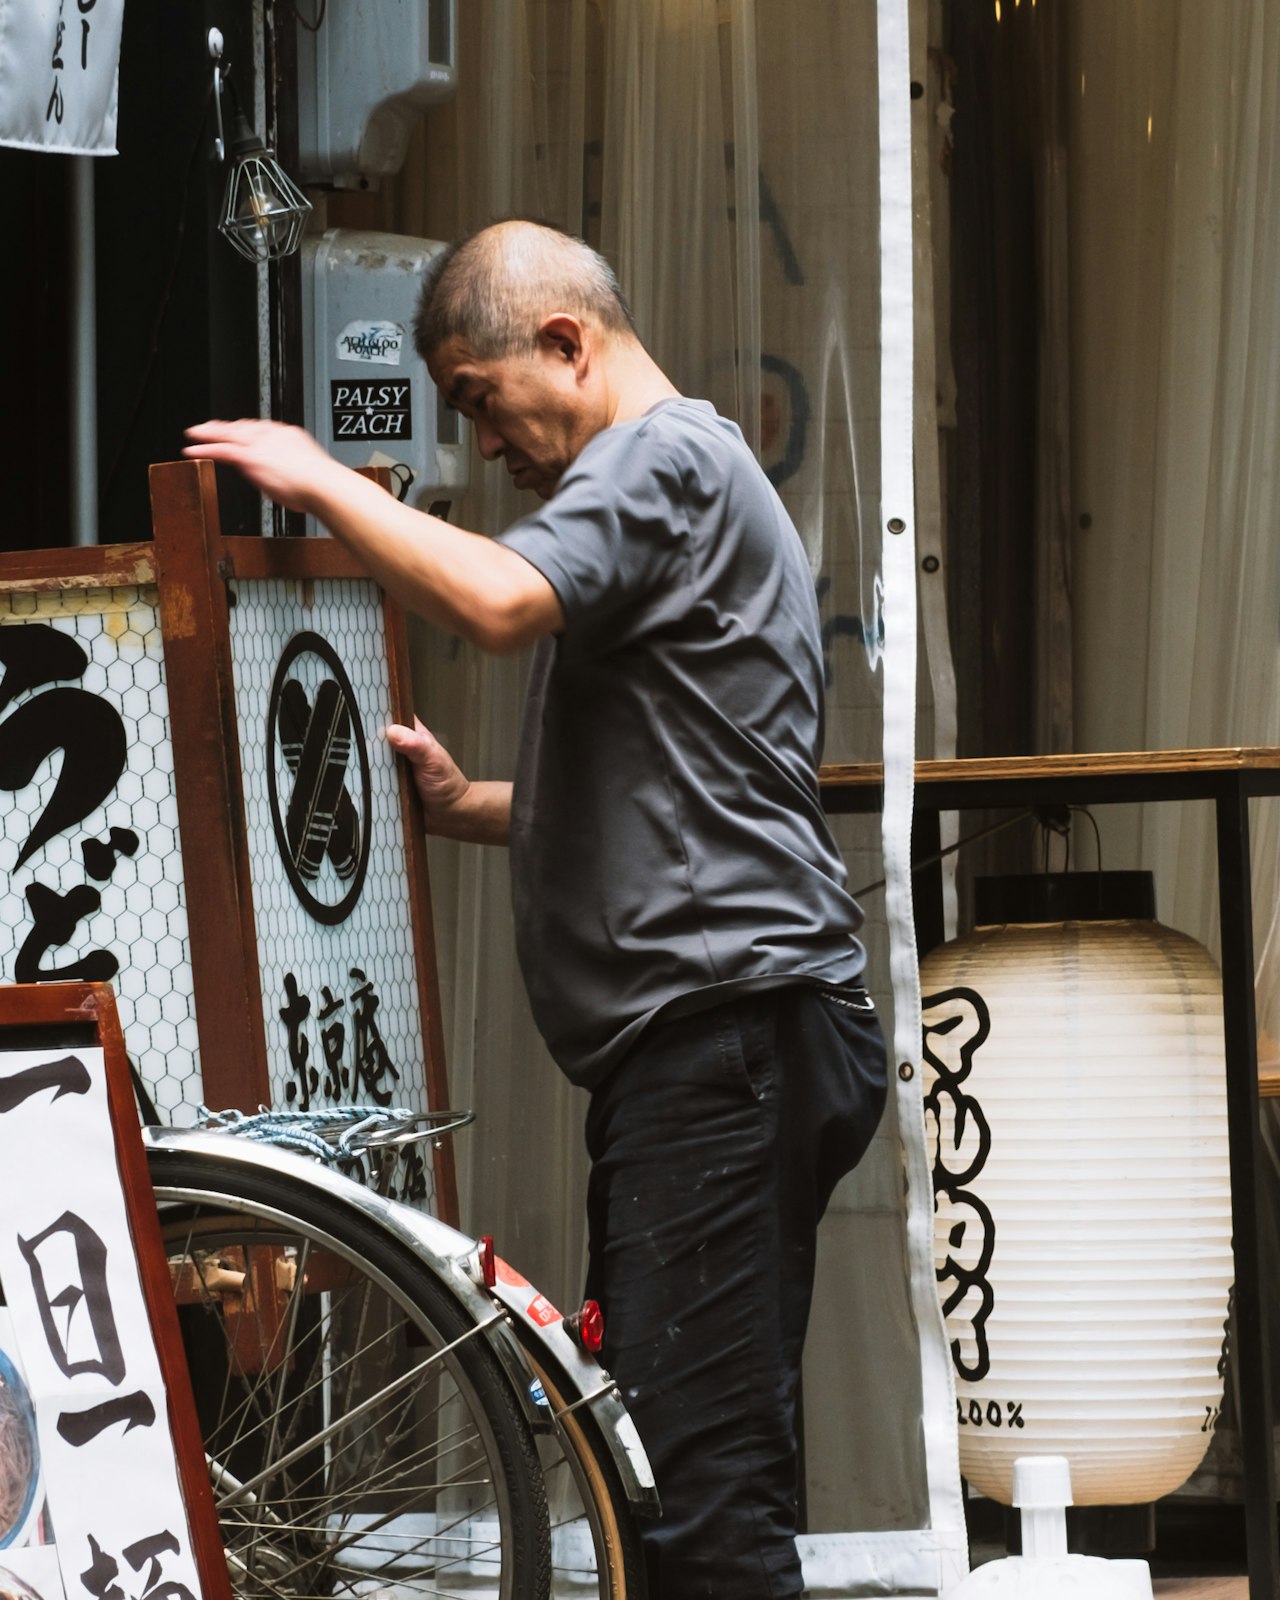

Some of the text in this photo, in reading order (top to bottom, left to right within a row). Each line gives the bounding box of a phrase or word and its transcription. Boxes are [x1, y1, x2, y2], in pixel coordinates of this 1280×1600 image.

[333, 385, 409, 408] PALSY
[337, 413, 405, 435] ZACH
[279, 967, 400, 1110] 東京庵
